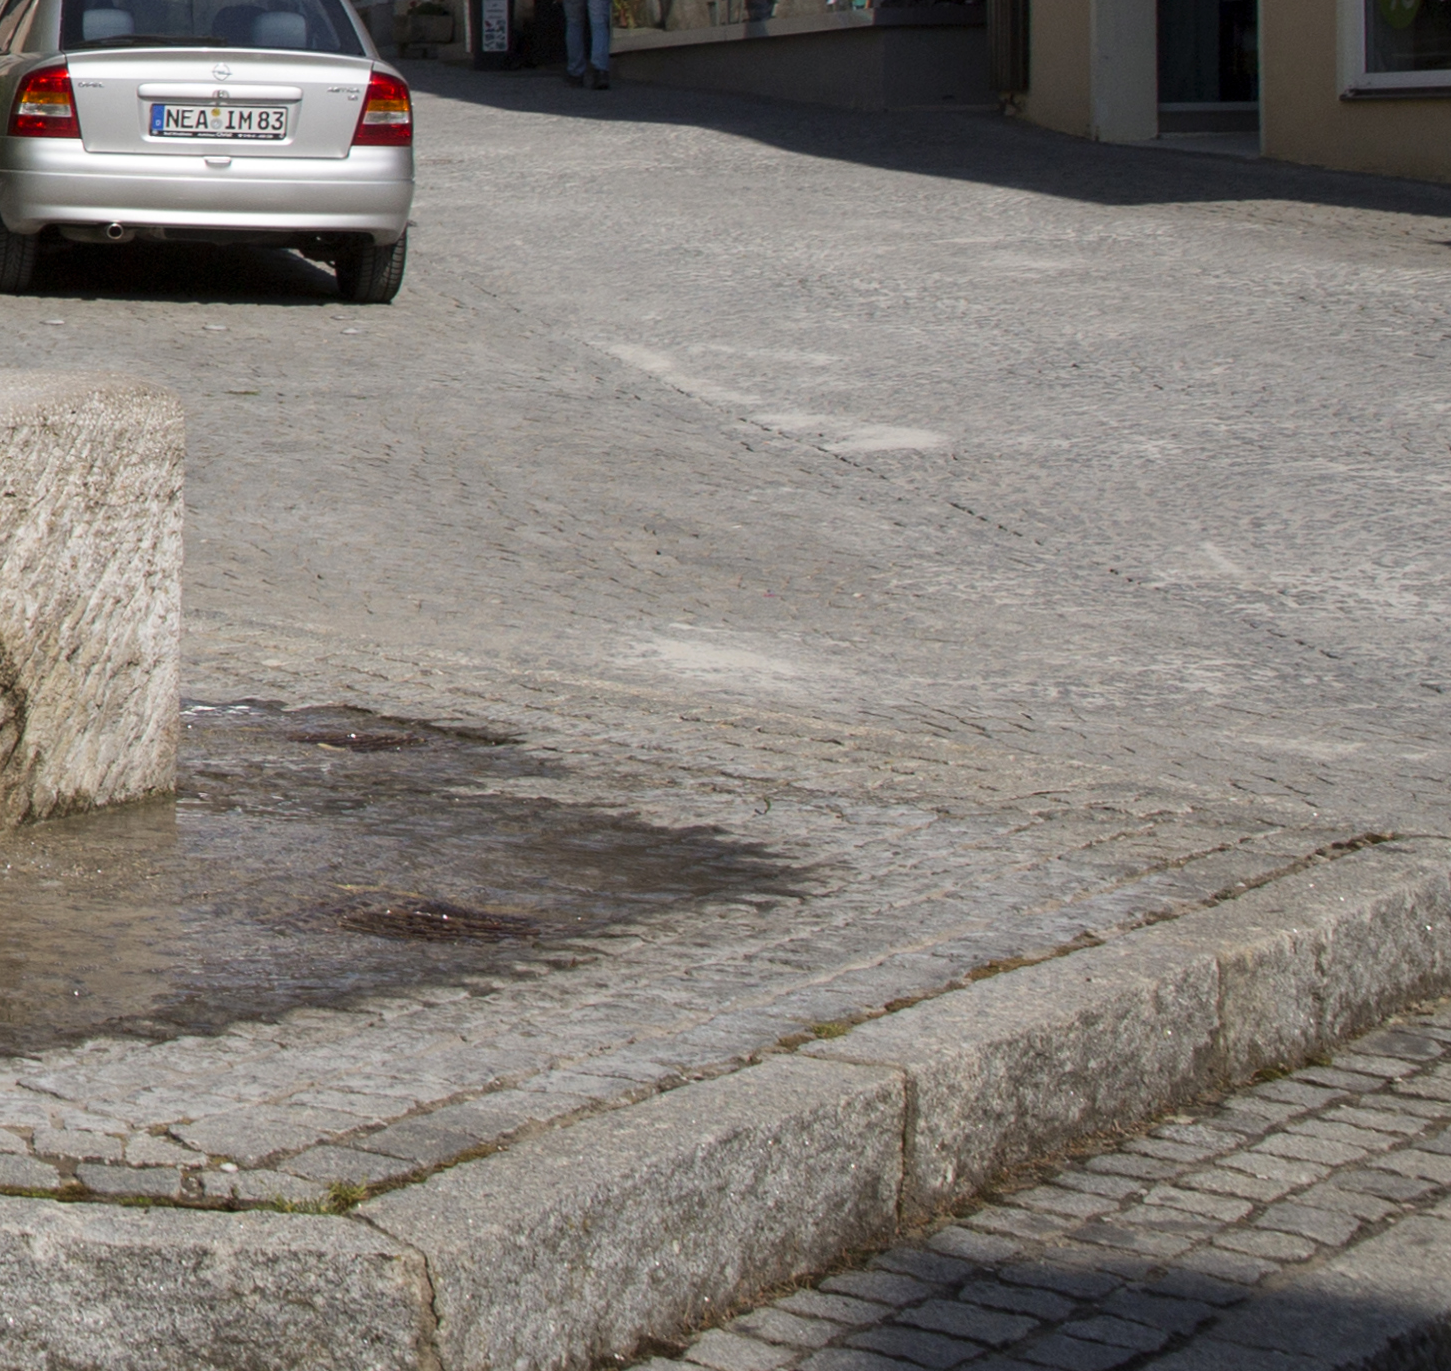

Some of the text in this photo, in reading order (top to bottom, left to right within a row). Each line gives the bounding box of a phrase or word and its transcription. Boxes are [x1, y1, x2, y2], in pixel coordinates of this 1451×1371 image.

[165, 109, 209, 129] NEA
[225, 110, 253, 130] IM
[258, 111, 285, 131] 83
